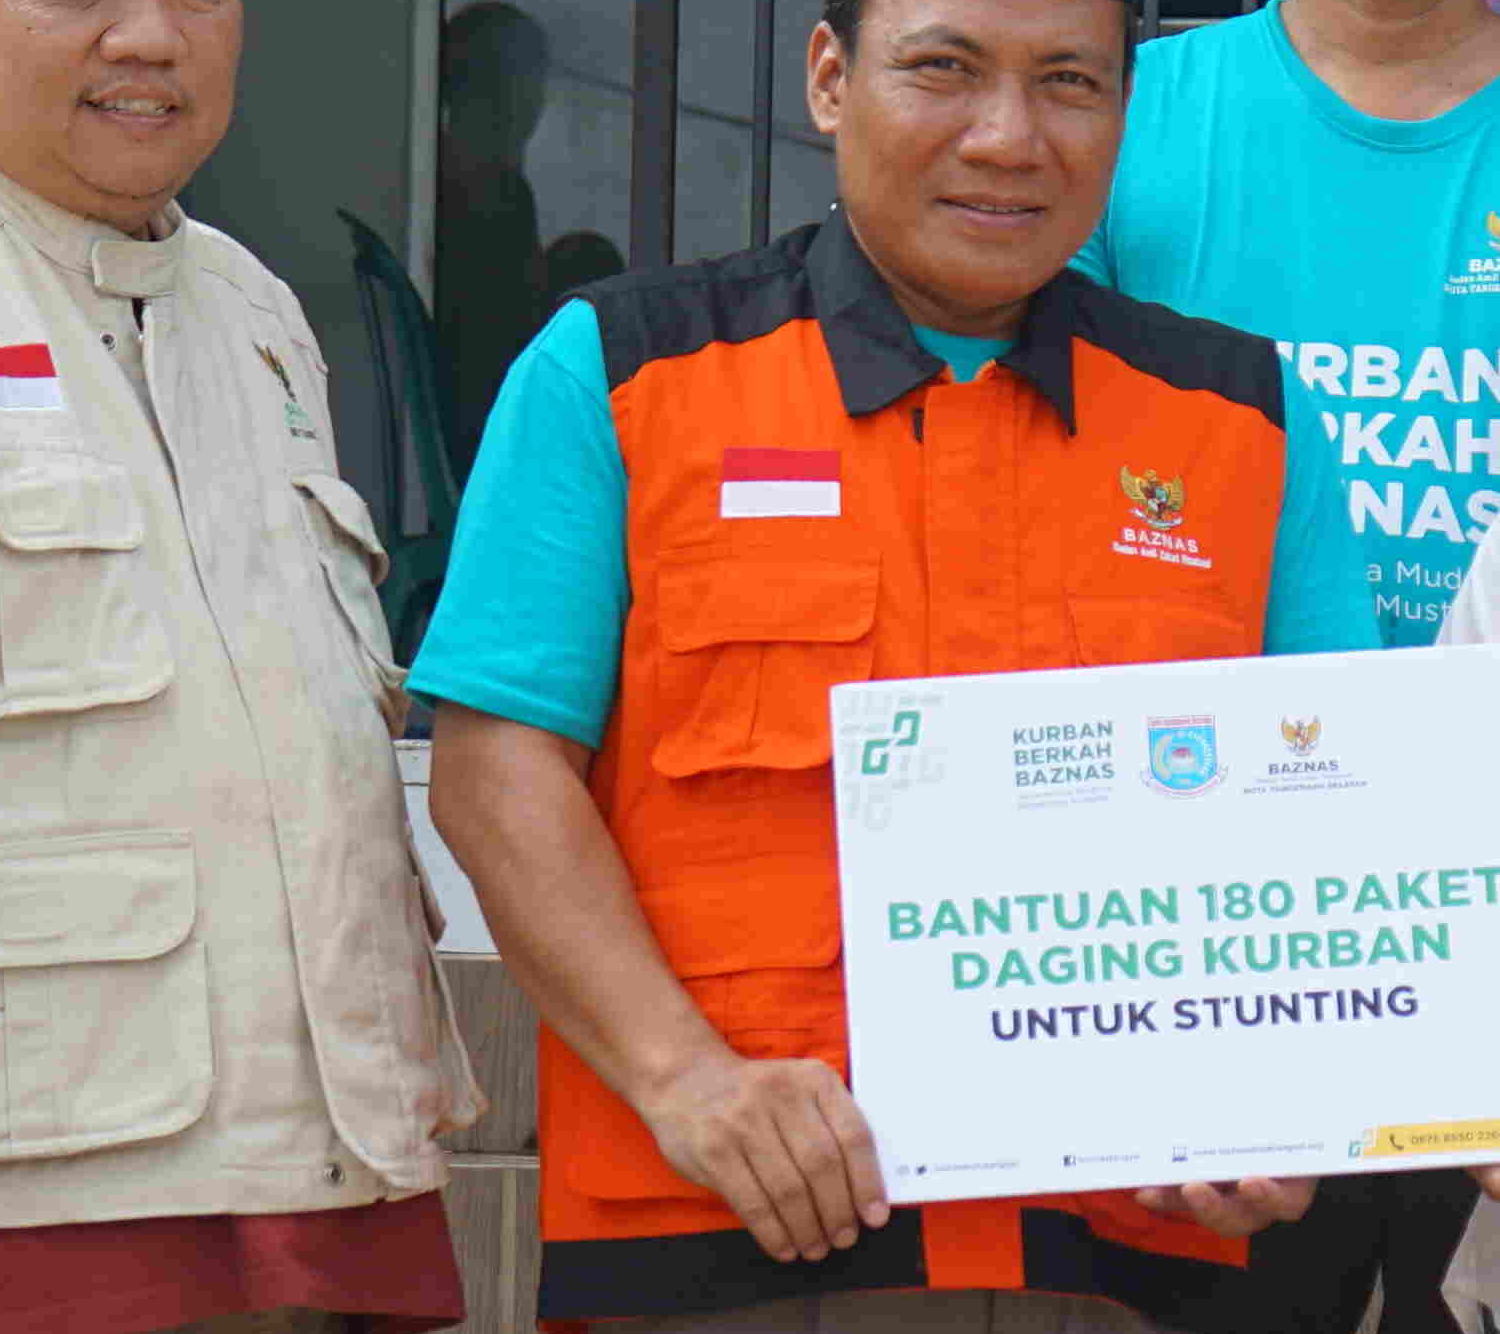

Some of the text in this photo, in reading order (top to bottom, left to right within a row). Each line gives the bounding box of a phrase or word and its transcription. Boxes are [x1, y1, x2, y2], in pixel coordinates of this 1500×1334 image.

[1122, 527, 1199, 554] BAZNAS
[1013, 722, 1113, 745] KURBAN
[1014, 742, 1112, 766] BERKAH
[1015, 763, 1115, 788] BAZNAS
[1268, 761, 1339, 775] BAZNAS
[887, 886, 1180, 941] BANTUAN
[1196, 879, 1296, 924] 180
[951, 922, 1452, 991] DAGING KURBAN
[991, 984, 1419, 1042] UNTUK STUNTING
